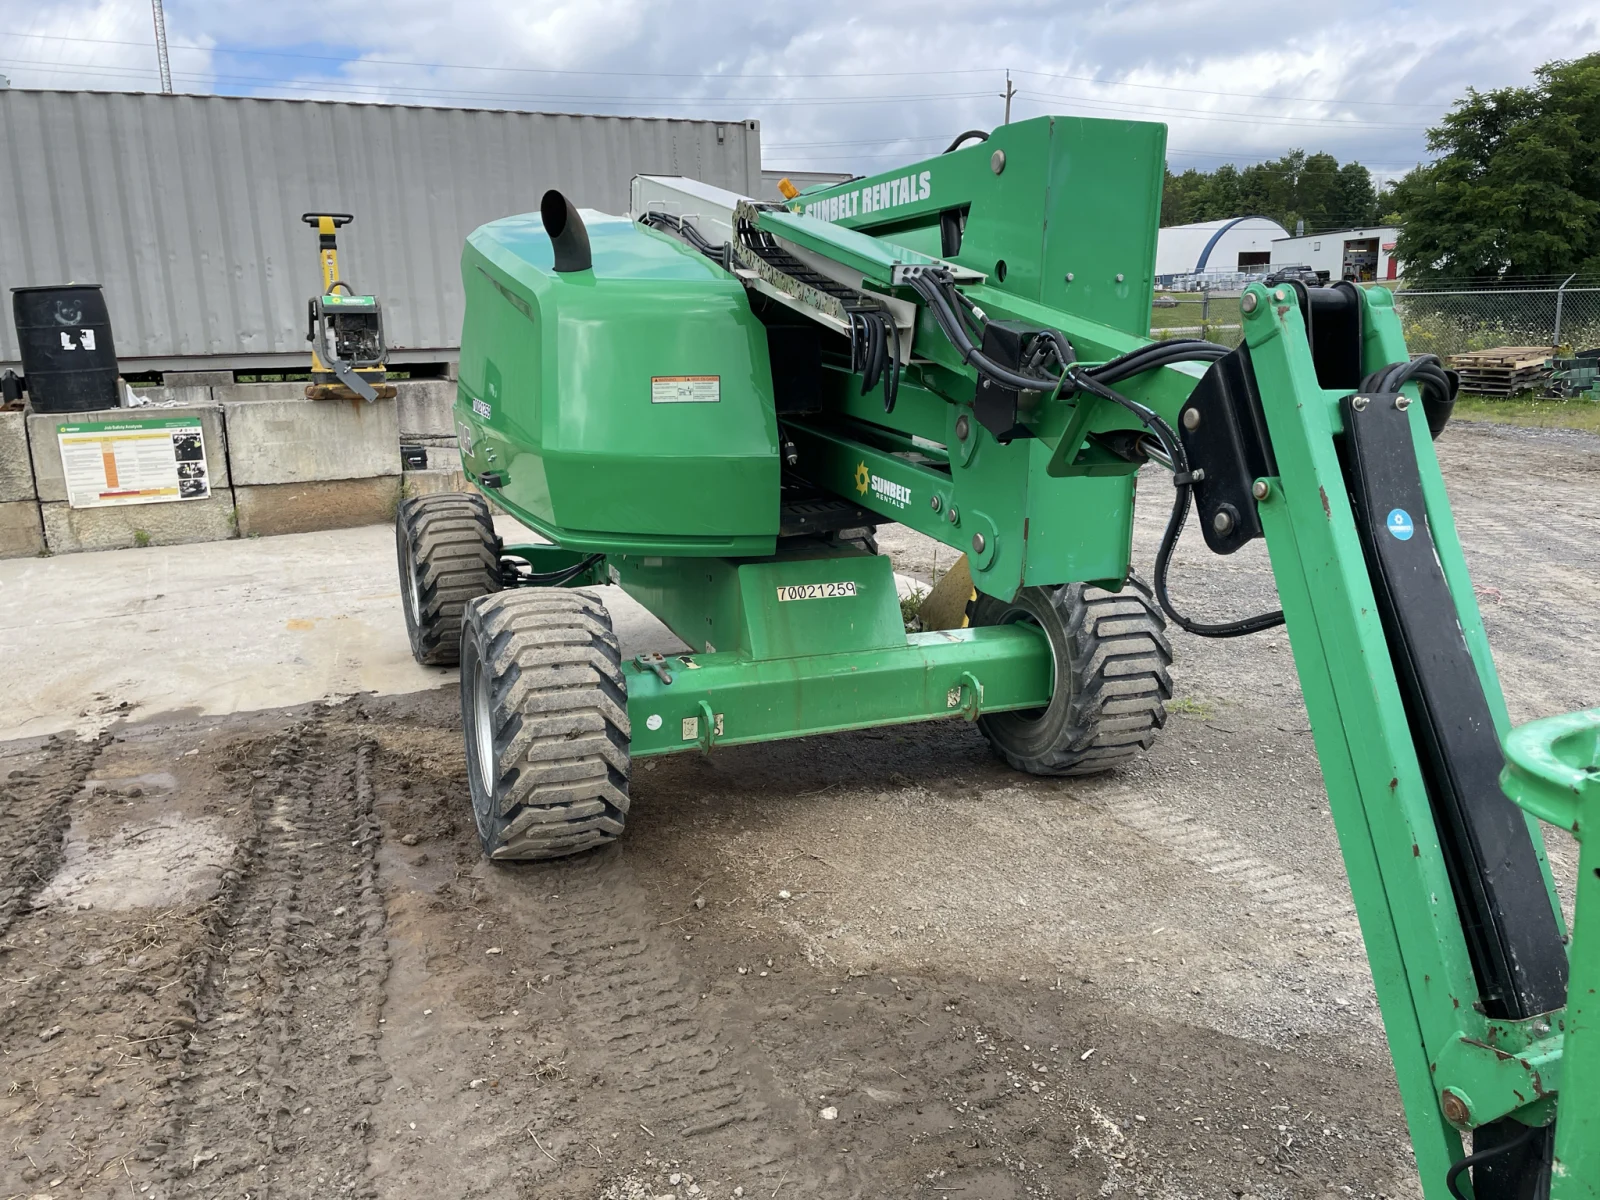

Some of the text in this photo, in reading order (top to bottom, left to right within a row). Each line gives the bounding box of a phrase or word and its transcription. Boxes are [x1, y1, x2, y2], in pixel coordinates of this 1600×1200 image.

[862, 171, 931, 213] RENTALS
[871, 474, 911, 504] SUNBELT
[876, 492, 904, 509] RENTALS
[778, 582, 855, 600] 70021259
